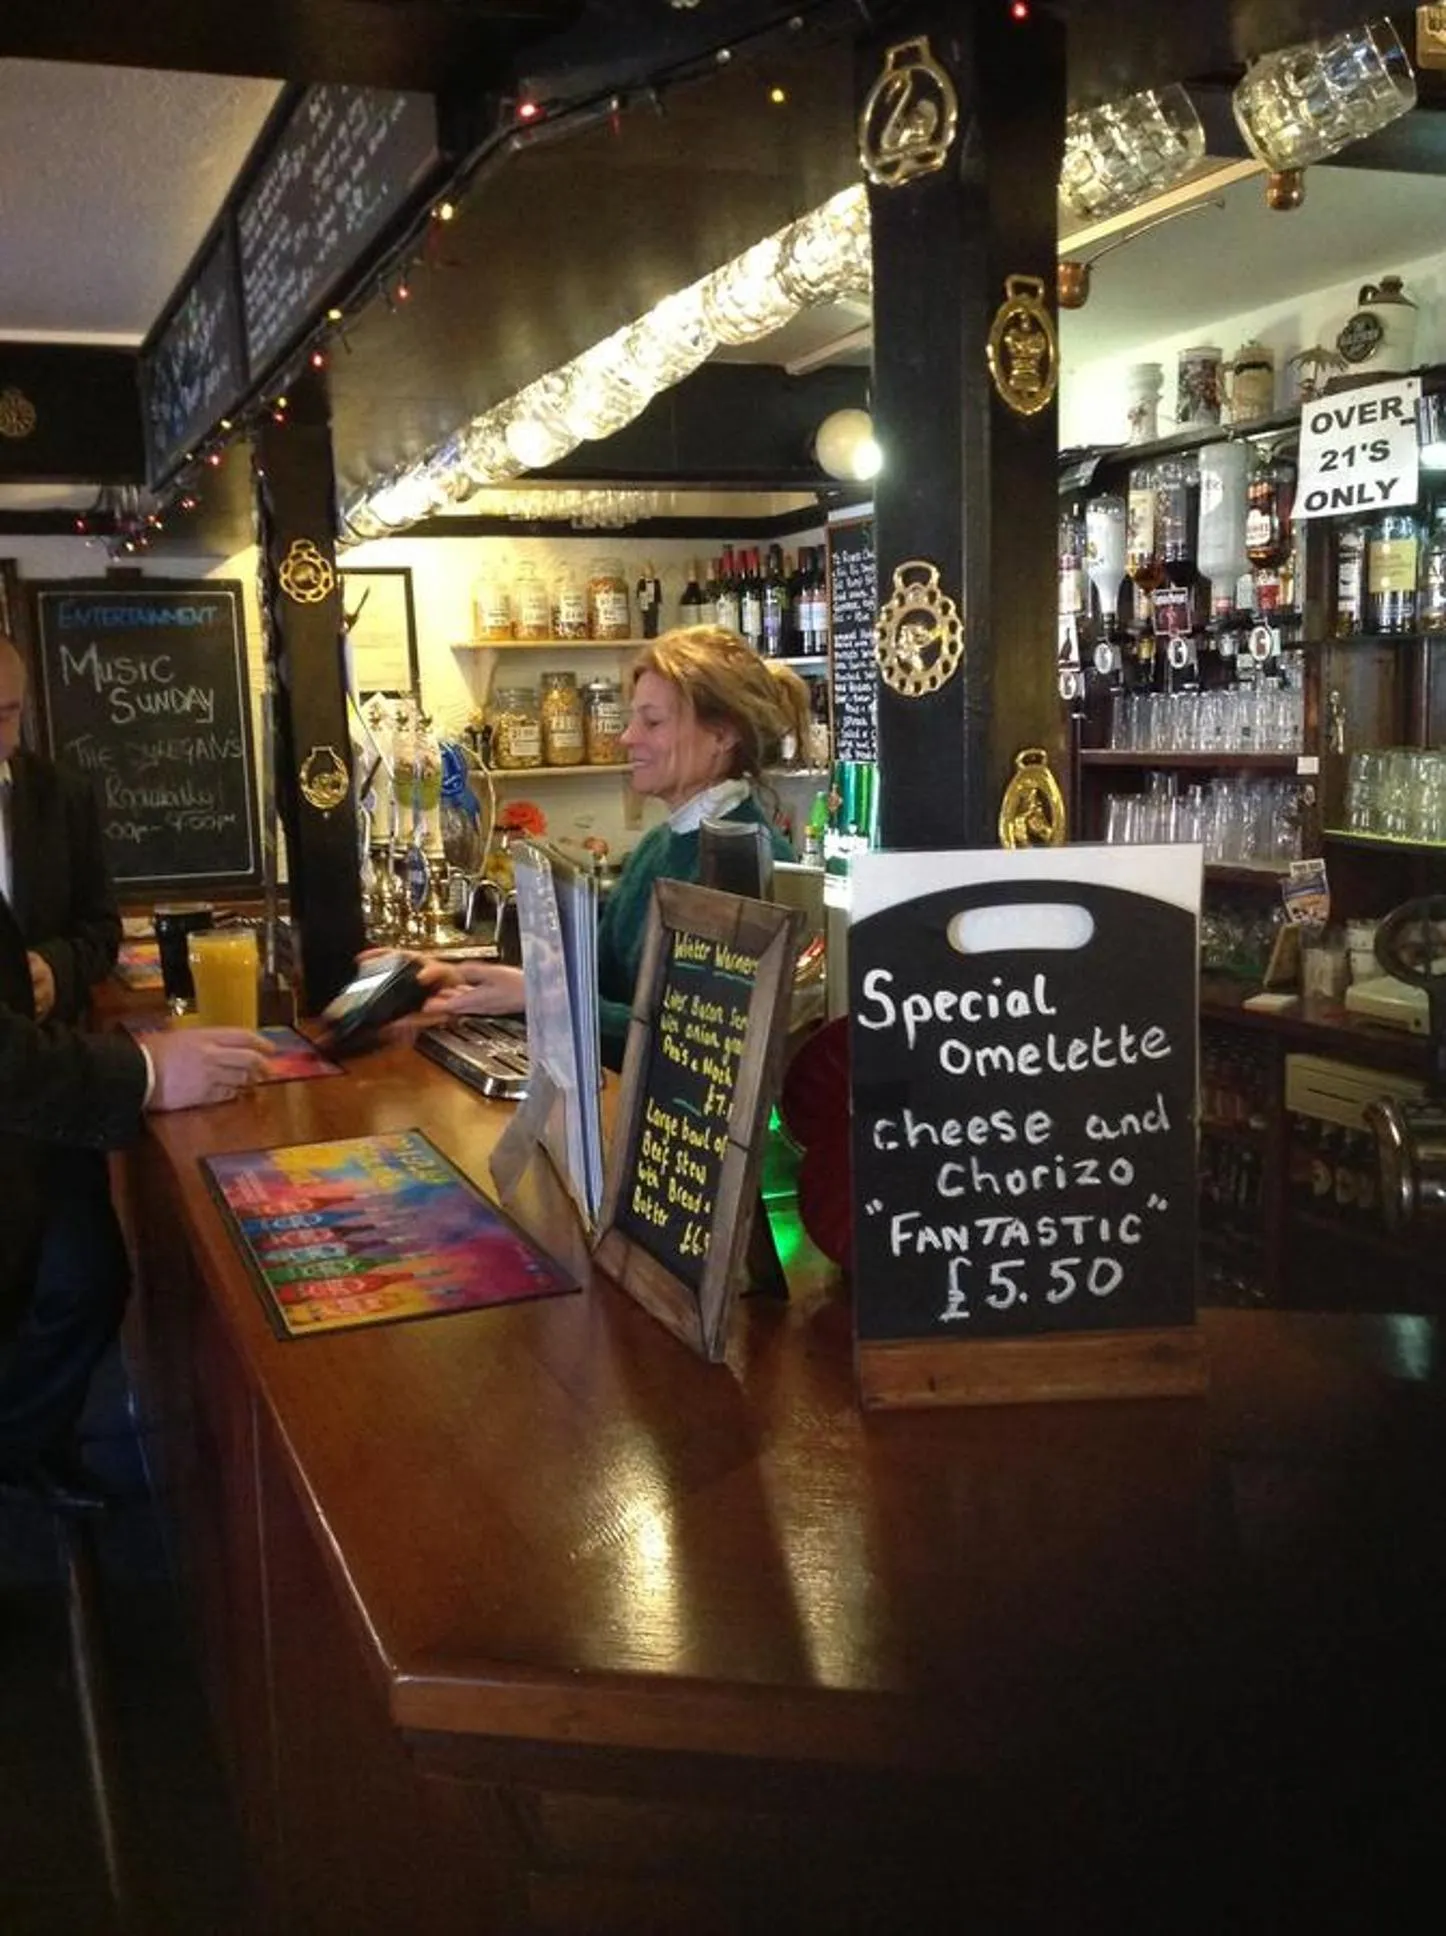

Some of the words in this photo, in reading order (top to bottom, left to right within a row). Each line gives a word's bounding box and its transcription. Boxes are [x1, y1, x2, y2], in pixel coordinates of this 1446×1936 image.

[1311, 395, 1403, 436] OVER
[1319, 439, 1391, 473] 21'S
[1304, 477, 1399, 512] ONLY
[857, 967, 1057, 1050] Special
[939, 1024, 1172, 1078] omelette
[873, 1107, 1053, 1152] cheese
[1085, 1093, 1172, 1141] and
[938, 1255, 1123, 1323] £5.50
